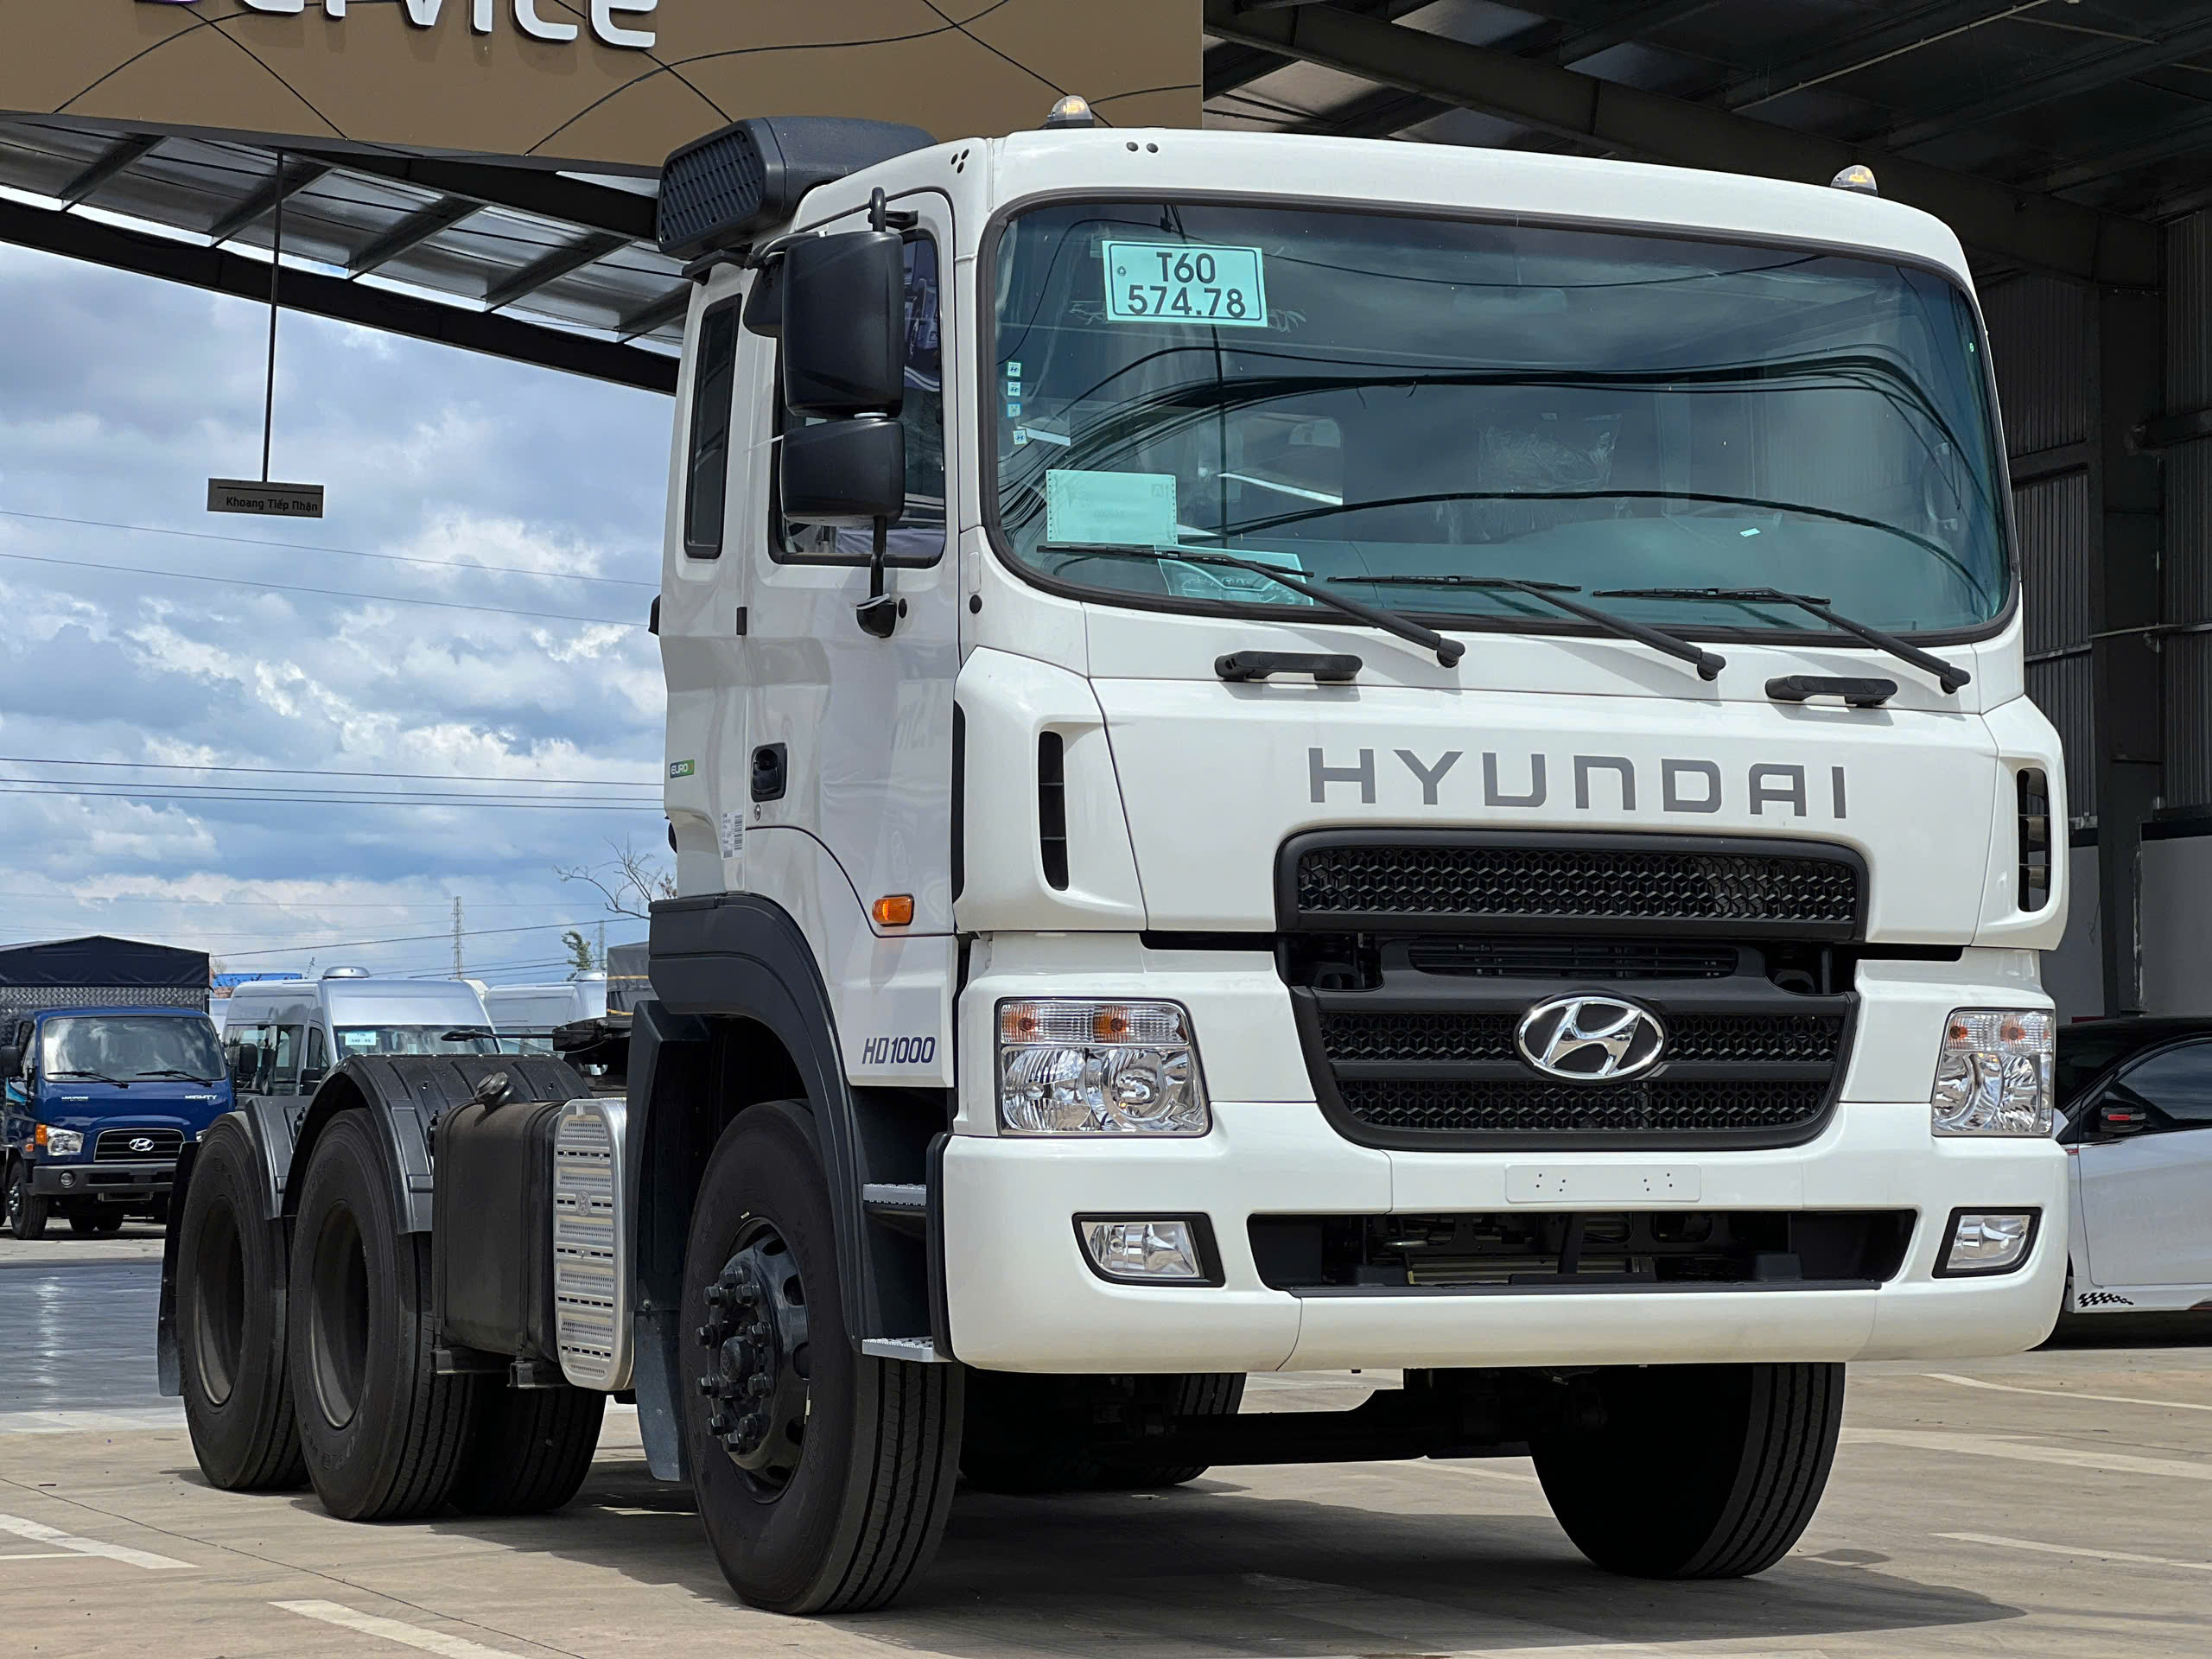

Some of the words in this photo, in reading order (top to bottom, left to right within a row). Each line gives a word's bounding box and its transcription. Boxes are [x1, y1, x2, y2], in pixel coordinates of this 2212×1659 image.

[1155, 251, 1217, 283] T60
[1128, 284, 1246, 318] 574.78
[226, 496, 264, 511] Khoang
[267, 498, 289, 512] Tiếp
[671, 763, 689, 775] EURO
[1307, 747, 1847, 819] HYUNDAI
